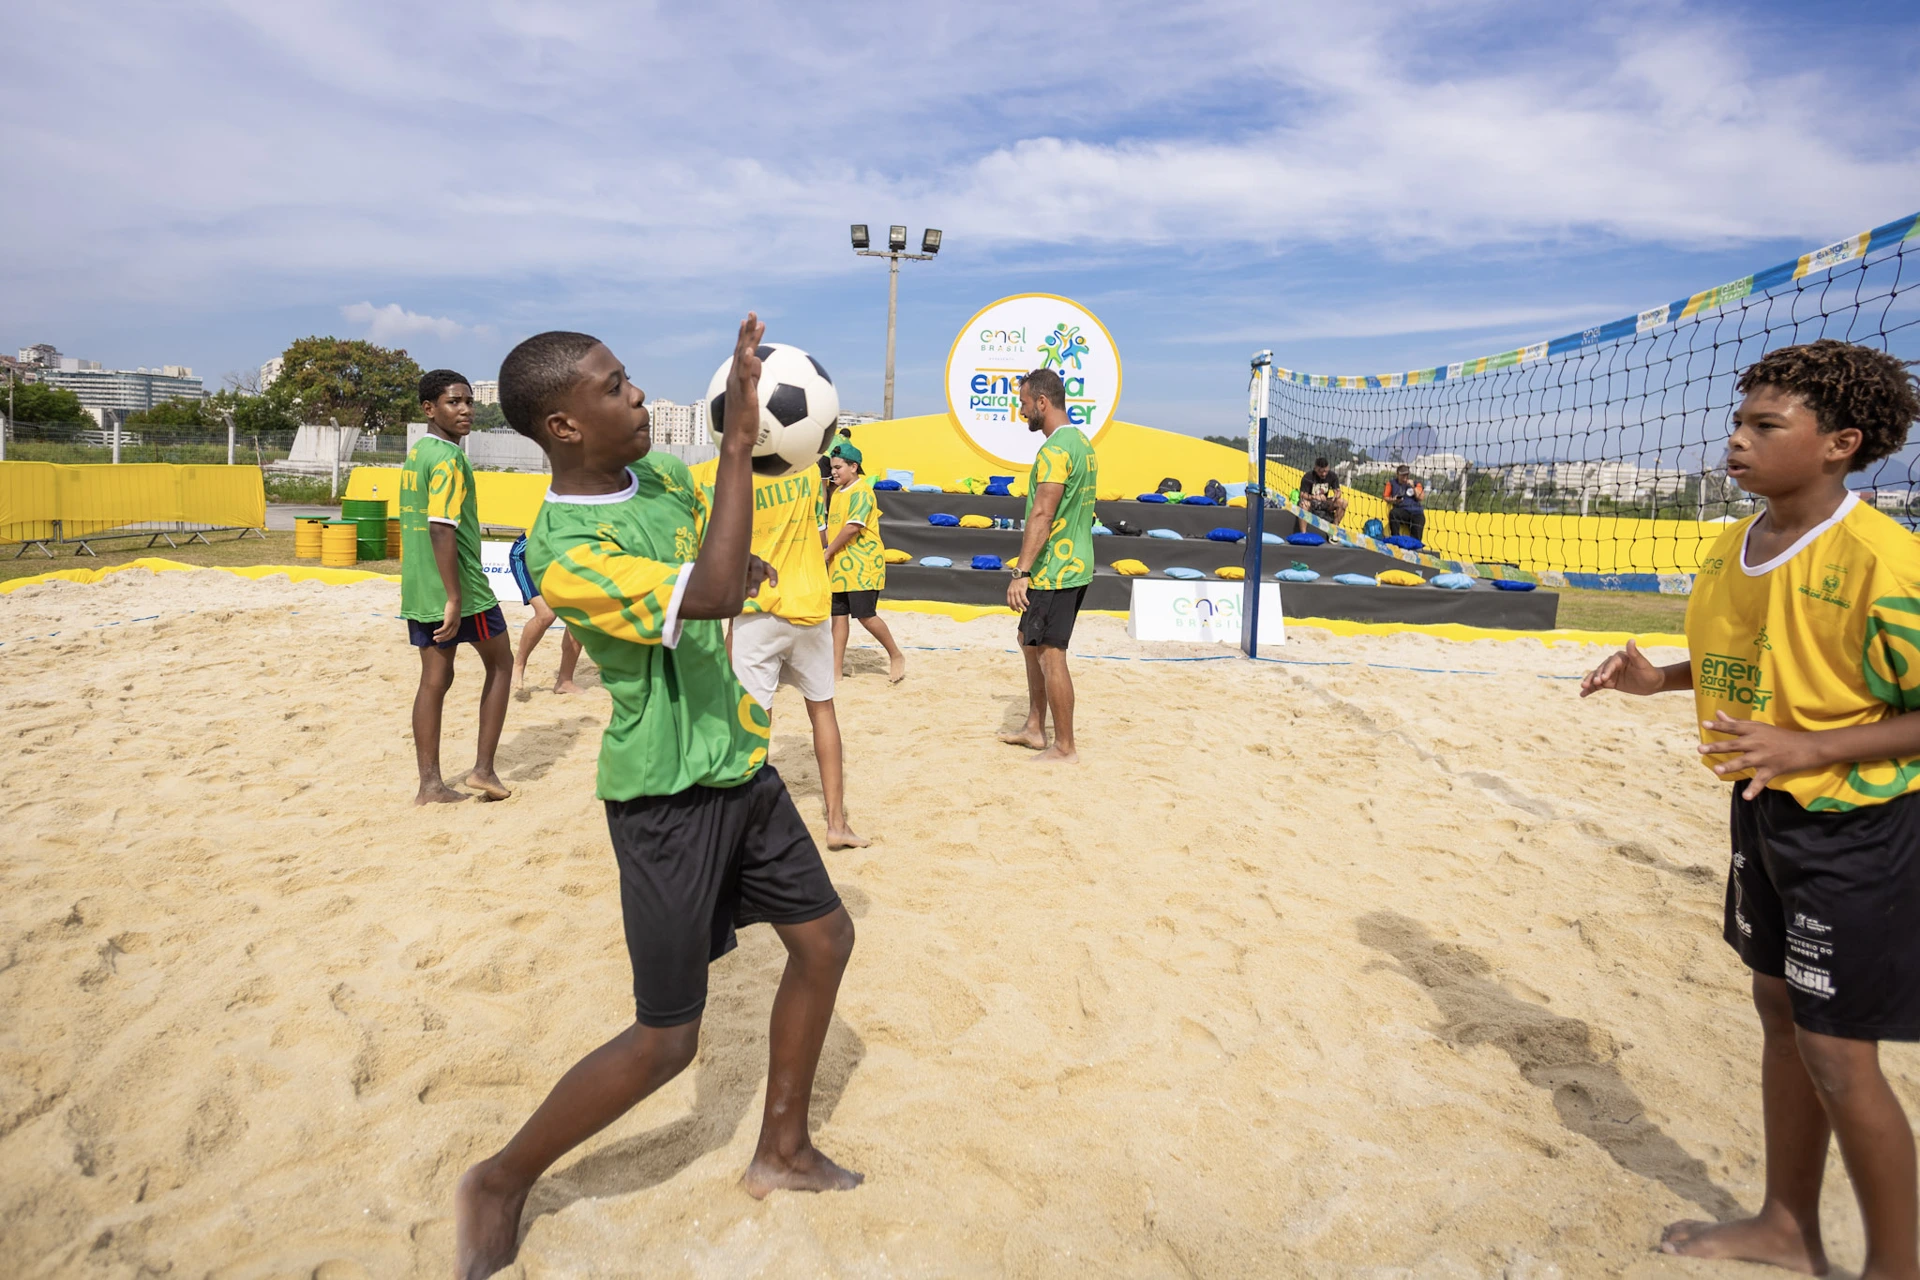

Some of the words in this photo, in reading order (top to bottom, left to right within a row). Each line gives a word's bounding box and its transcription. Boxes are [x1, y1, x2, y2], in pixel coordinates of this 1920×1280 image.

[980, 326, 1027, 344] enel
[980, 345, 1025, 353] BRASIL
[970, 369, 1085, 398] eneia
[970, 395, 1008, 409] para
[976, 413, 1006, 421] 2026
[755, 476, 811, 511] ATLETA
[1173, 593, 1242, 616] enel
[1175, 618, 1241, 628] BRASIL
[1700, 674, 1727, 688] para
[1701, 690, 1724, 699] 2026
[1819, 946, 1833, 956] DO
